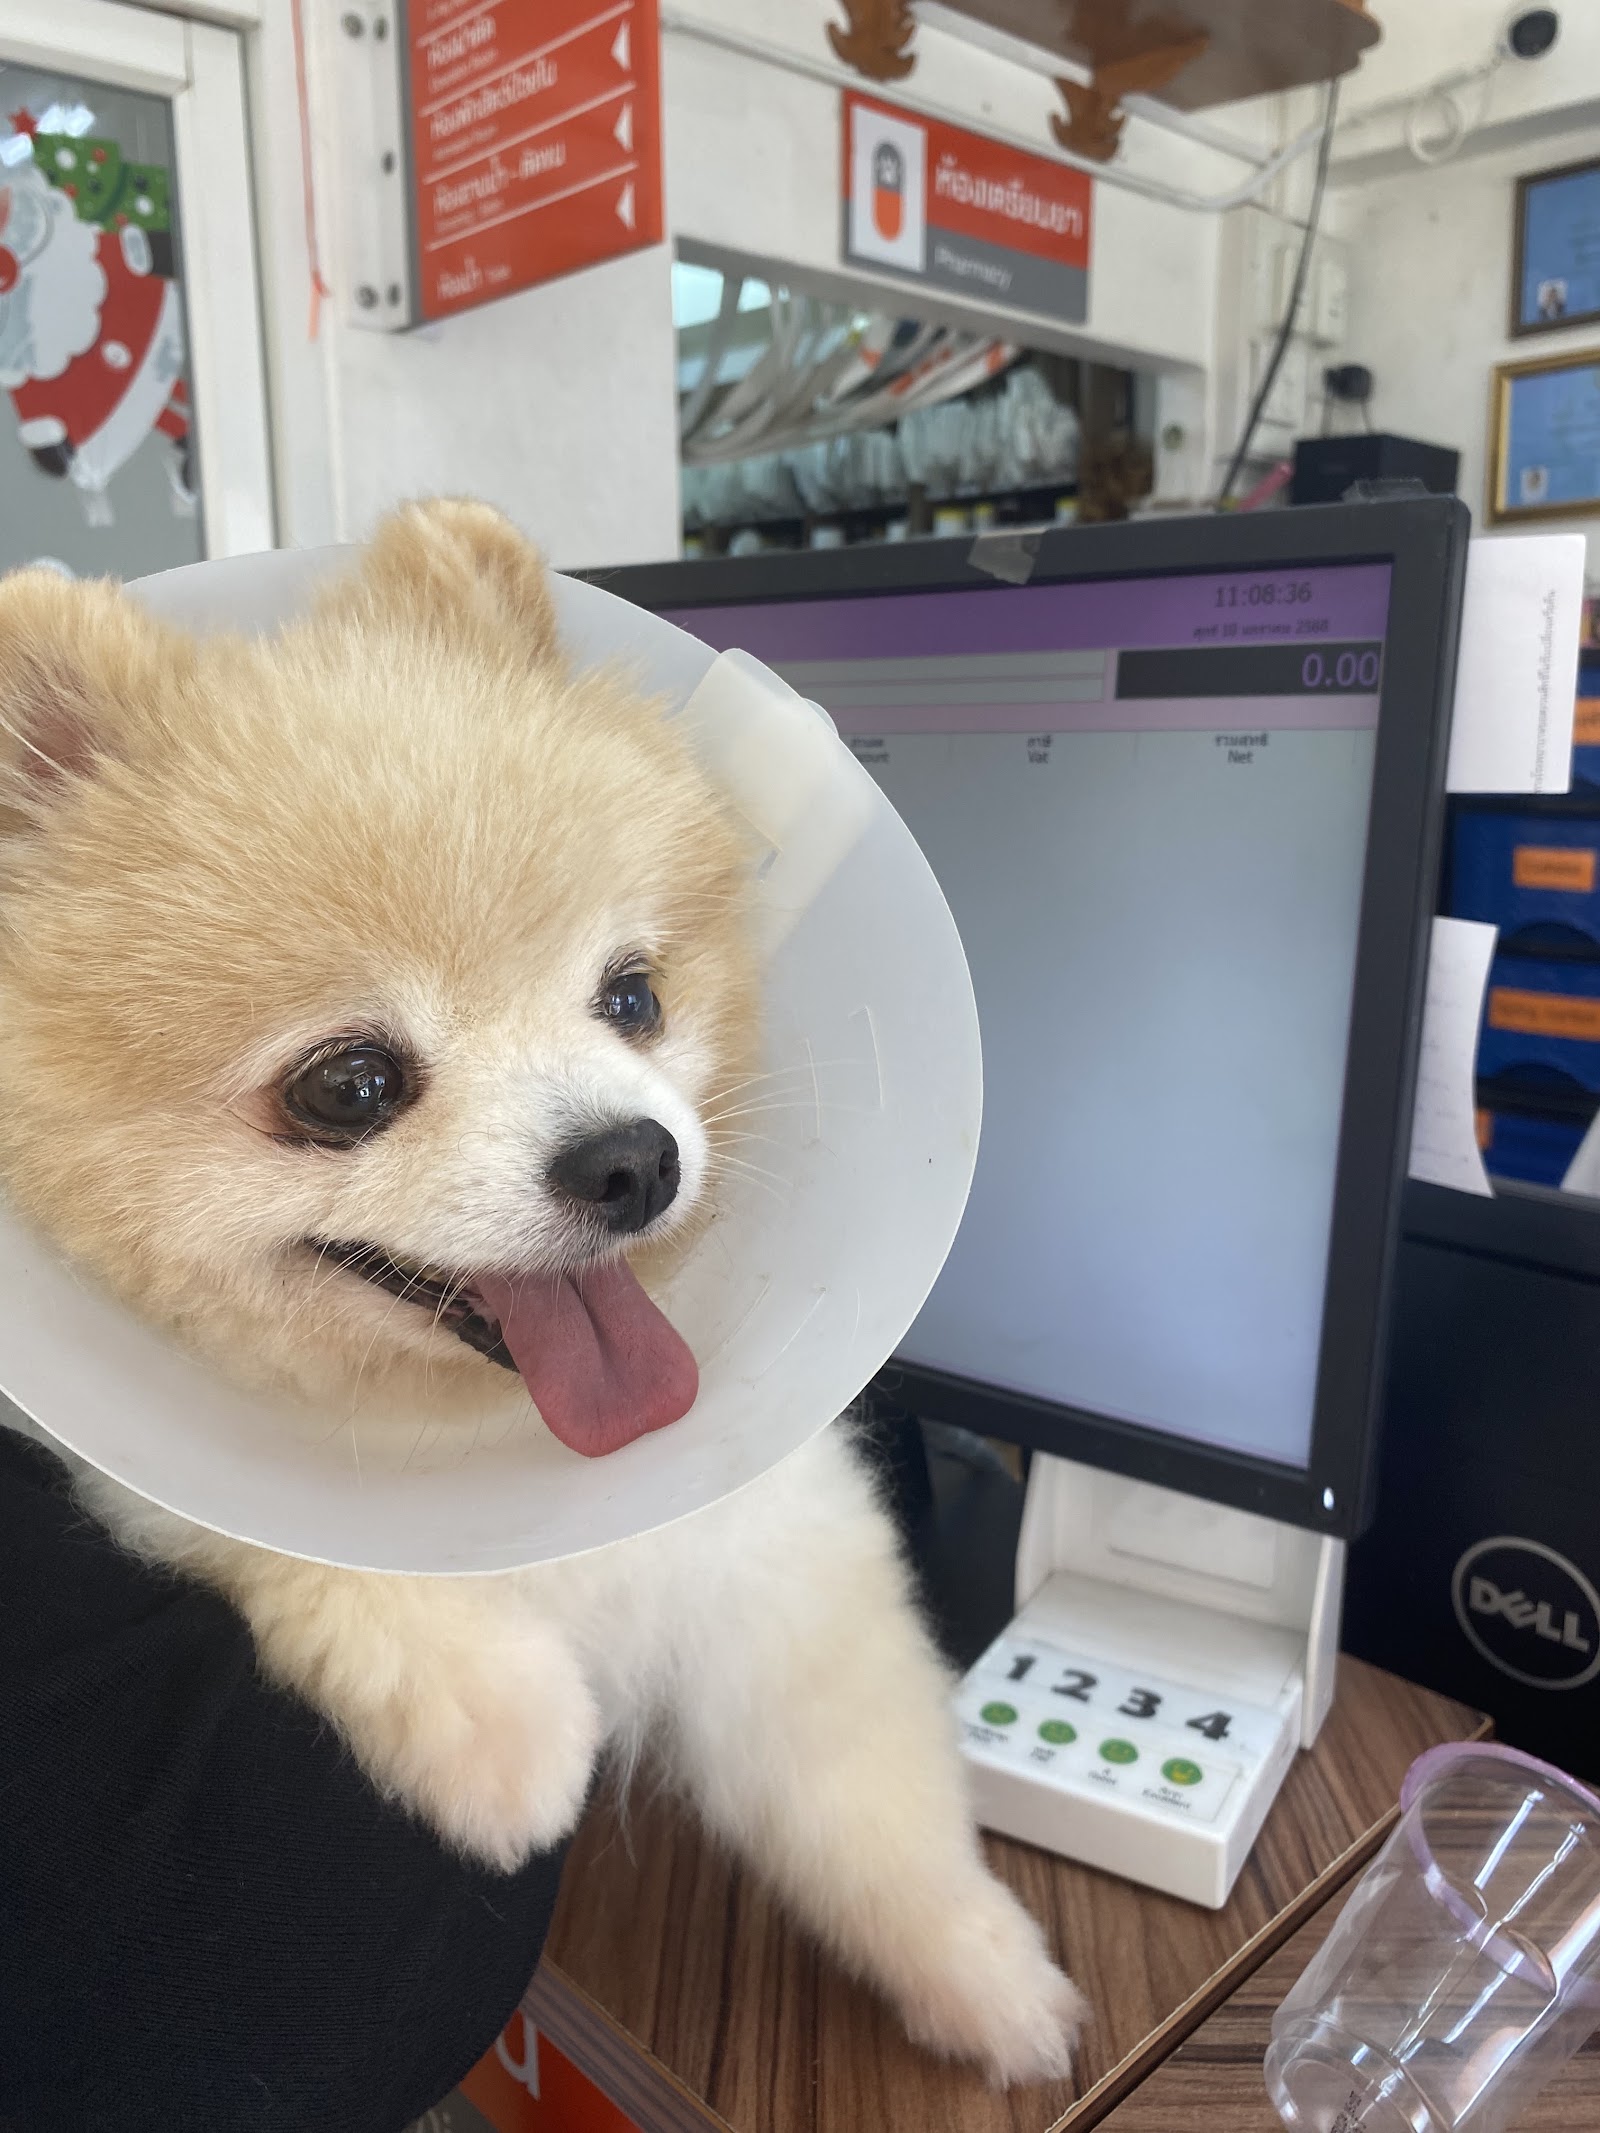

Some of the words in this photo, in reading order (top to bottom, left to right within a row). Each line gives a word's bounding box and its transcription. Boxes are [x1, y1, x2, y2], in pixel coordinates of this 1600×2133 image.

[935, 153, 1082, 240] ห้องเตรียมยา
[934, 246, 1012, 292] Pharmacy
[1214, 581, 1313, 608] 11:08:36
[1301, 652, 1379, 688] 0.00
[1027, 750, 1049, 764] Vat
[1227, 750, 1255, 764] Net
[1470, 1575, 1590, 1653] DELL
[1007, 1655, 1036, 1681] 1
[1051, 1668, 1098, 1703] 2
[1117, 1687, 1163, 1719] 3
[1186, 1711, 1233, 1741] 4
